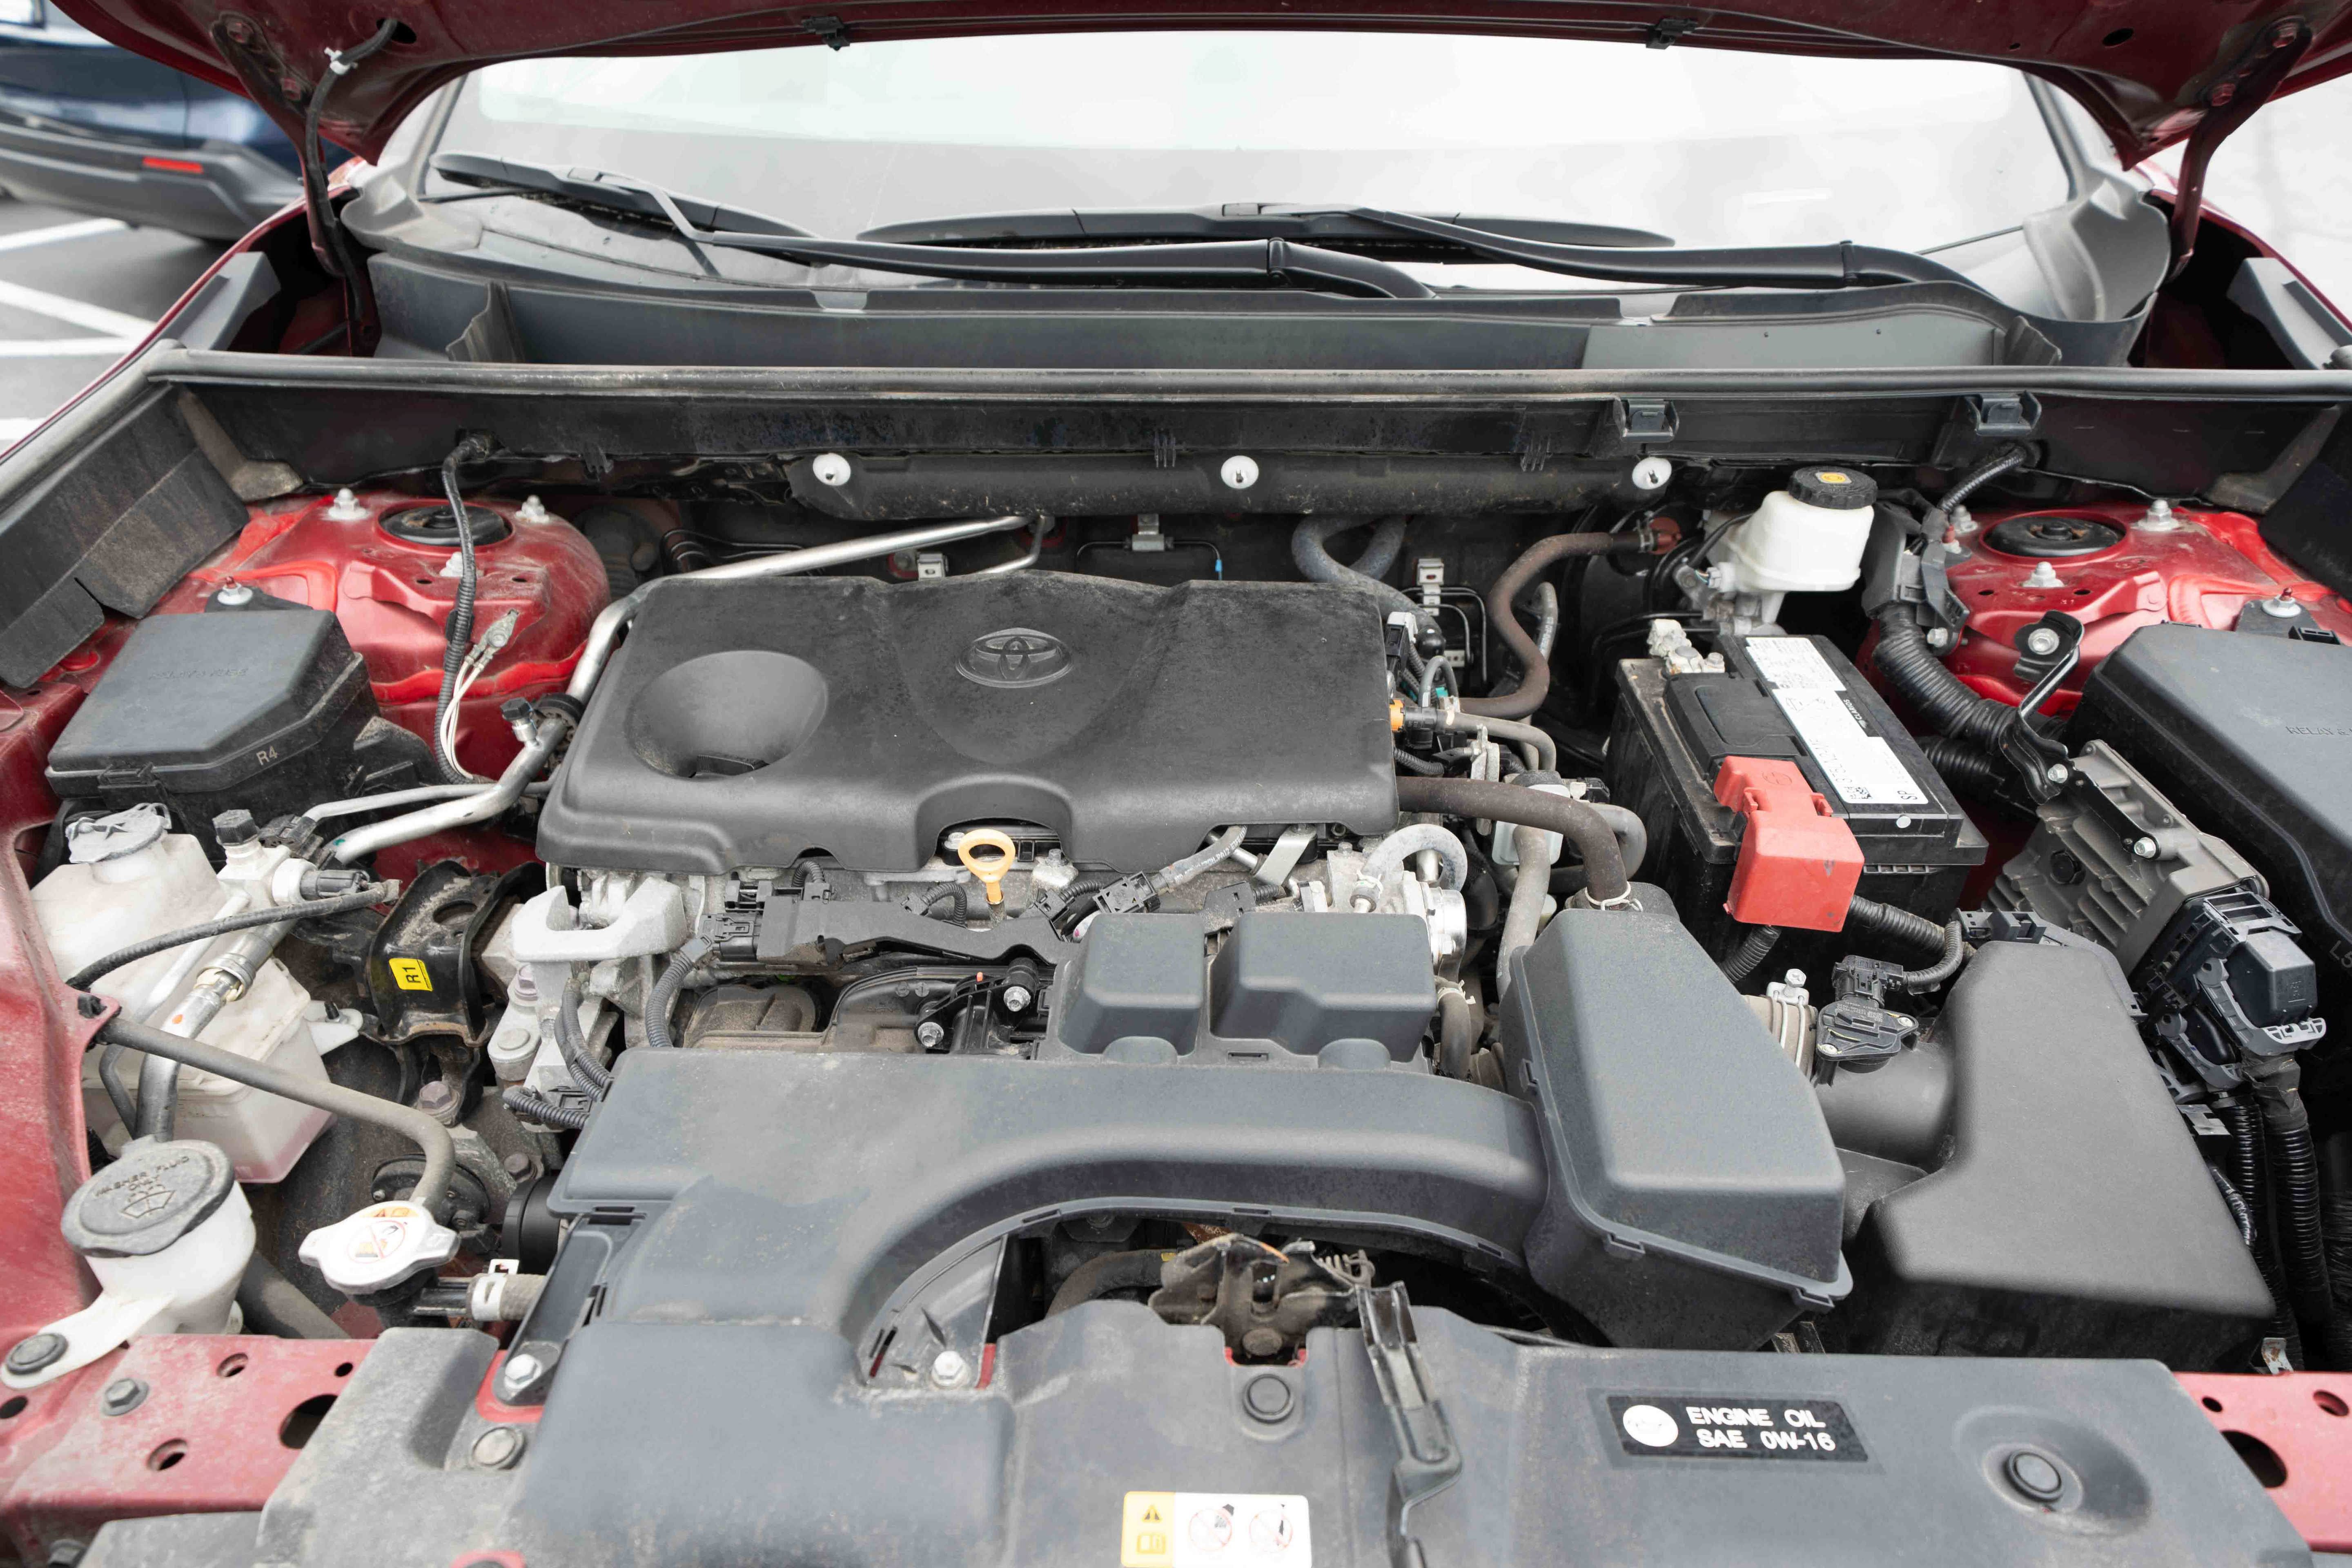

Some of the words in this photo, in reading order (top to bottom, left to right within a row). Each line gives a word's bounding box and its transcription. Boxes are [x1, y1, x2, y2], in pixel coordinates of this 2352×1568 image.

[1843, 699, 1862, 720] CLARIOS
[2285, 726, 2334, 736] RELAY
[256, 746, 278, 766] R4
[402, 967, 422, 983] R1
[96, 1171, 147, 1197] WASHER
[156, 1156, 190, 1173] FLUID
[1685, 1406, 1773, 1427] ENGINE
[1784, 1409, 1826, 1428] OIL
[1696, 1428, 1748, 1449] SAE
[1760, 1431, 1836, 1451] 0W-16
